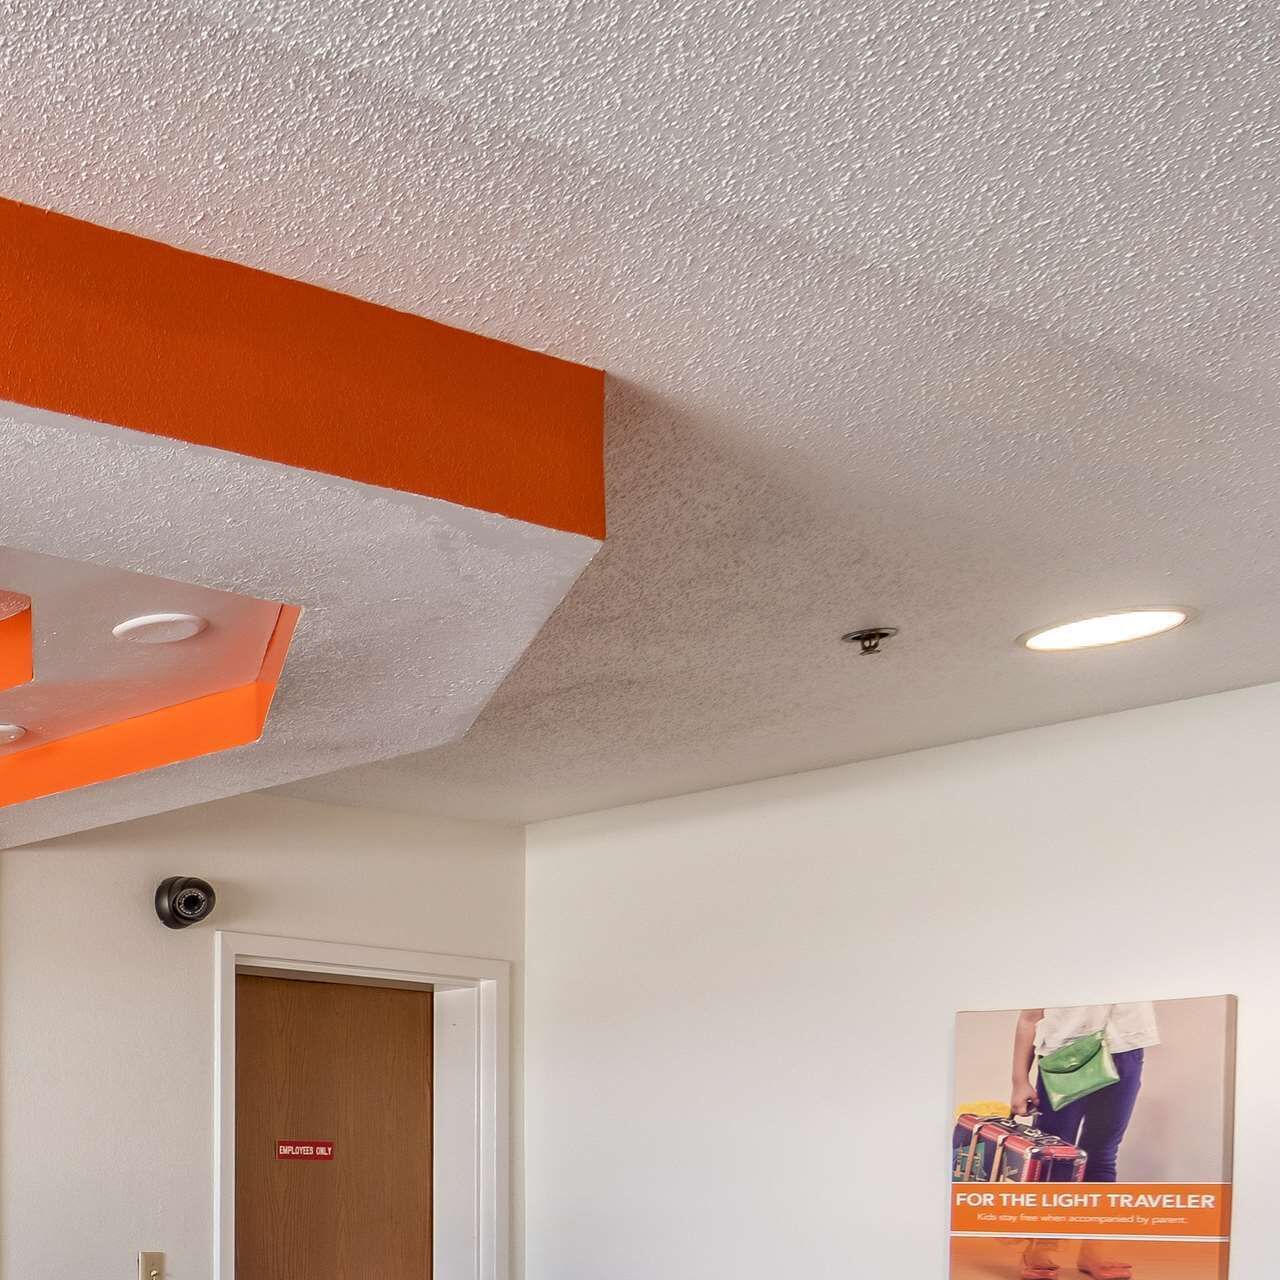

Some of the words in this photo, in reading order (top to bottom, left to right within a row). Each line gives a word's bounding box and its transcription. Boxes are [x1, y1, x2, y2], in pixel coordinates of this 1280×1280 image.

[279, 1145, 314, 1155] EMPLOYEES
[315, 1146, 332, 1156] ONLY
[956, 1192, 994, 1206] FOR
[998, 1193, 1037, 1207] THE
[1042, 1193, 1102, 1208] LIGHT
[1107, 1194, 1216, 1209] TRAVELER
[976, 1213, 997, 1222] Kids
[999, 1214, 1018, 1223] stay
[1020, 1213, 1039, 1222] free
[1040, 1213, 1066, 1222] when
[1068, 1214, 1134, 1225] accompanied
[1136, 1215, 1150, 1225] by
[1151, 1216, 1188, 1225] parent.
